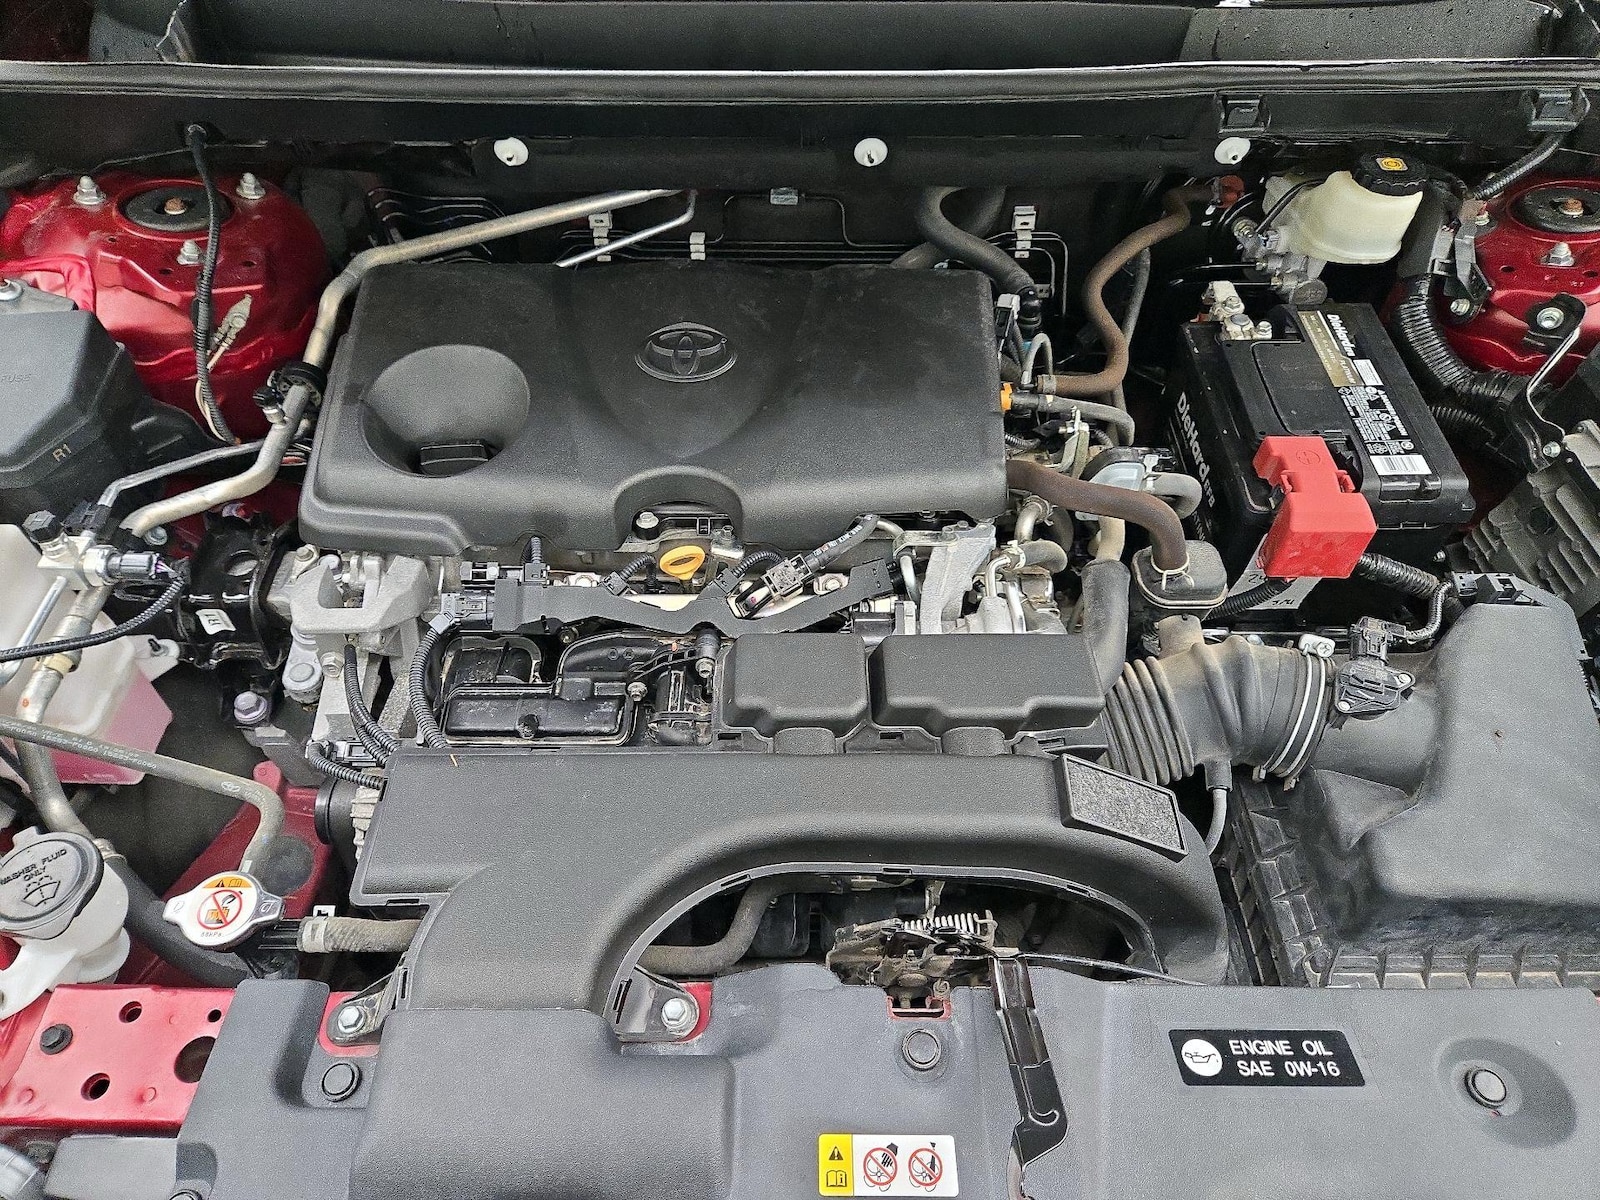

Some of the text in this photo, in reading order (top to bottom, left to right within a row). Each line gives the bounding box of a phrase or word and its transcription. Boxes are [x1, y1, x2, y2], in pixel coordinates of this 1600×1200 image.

[1326, 314, 1356, 349] DieHard
[1177, 391, 1210, 482] DieHard
[52, 443, 72, 462] R1
[0, 849, 67, 885] WASHER FLUID
[24, 865, 46, 881] ONLY
[1228, 1039, 1334, 1056] ENGINE OIL
[1236, 1060, 1341, 1077] SAE 0W-16
